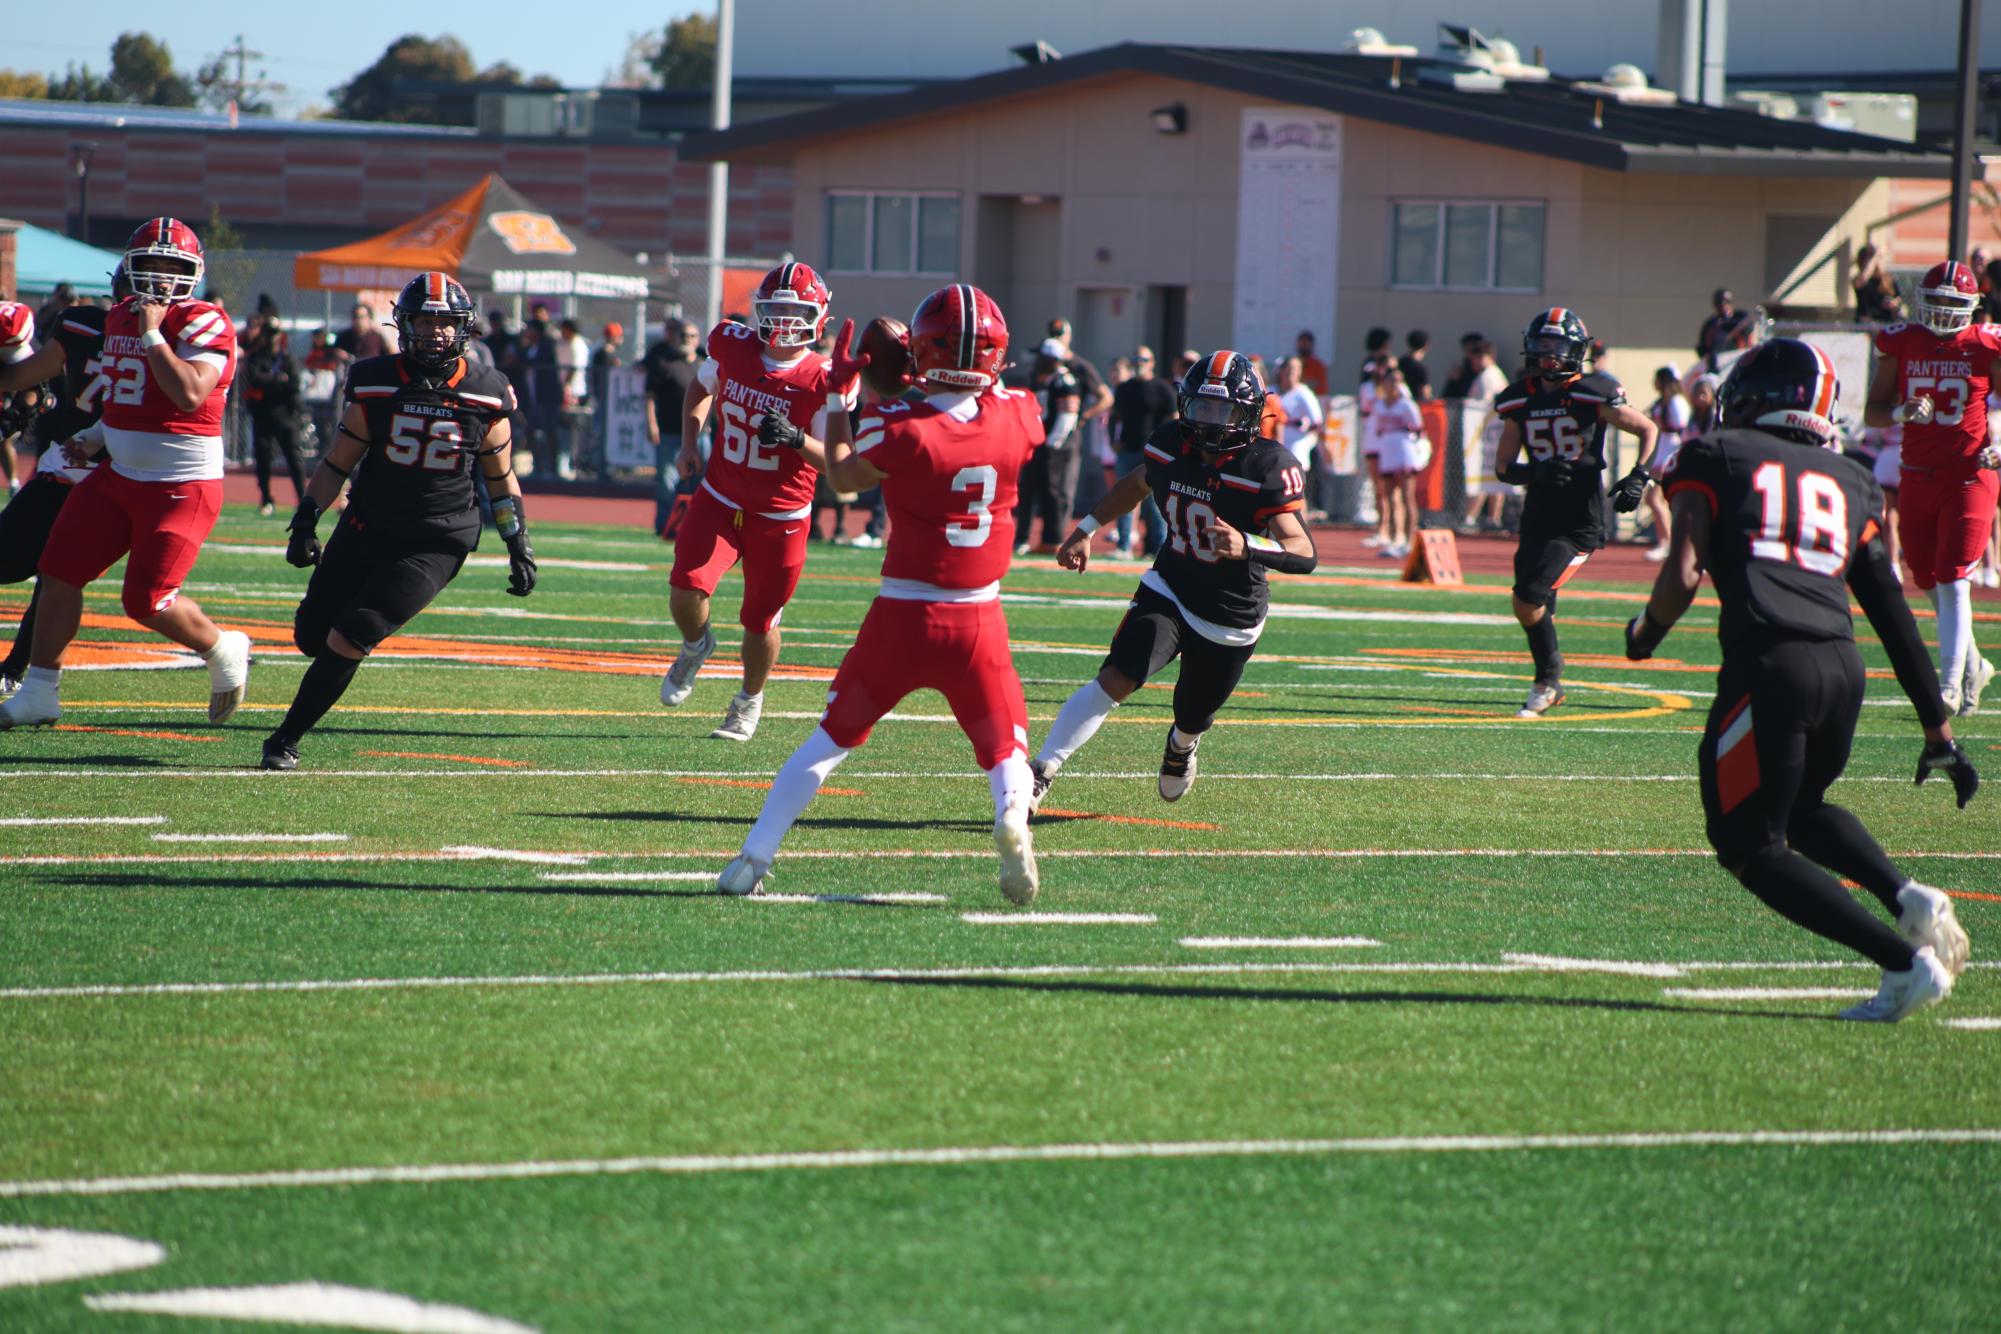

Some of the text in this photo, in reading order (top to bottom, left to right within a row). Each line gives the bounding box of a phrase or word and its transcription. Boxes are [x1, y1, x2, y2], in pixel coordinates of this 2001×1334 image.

[103, 335, 148, 356] ANTHERS
[937, 370, 983, 385] Riddell
[1906, 360, 1972, 377] PANTHERS
[723, 378, 791, 417] PANTHERS
[1200, 386, 1226, 395] Riddell
[1906, 377, 1969, 425] 53
[403, 404, 453, 418] BEARCATS
[385, 413, 462, 471] 52
[721, 400, 780, 471] 62
[1525, 416, 1583, 462] 56
[1169, 480, 1212, 502] BEARCATS
[1281, 466, 1304, 496] 10
[945, 464, 998, 547] 3
[1752, 461, 1848, 577] 18
[1166, 494, 1220, 563] 10
